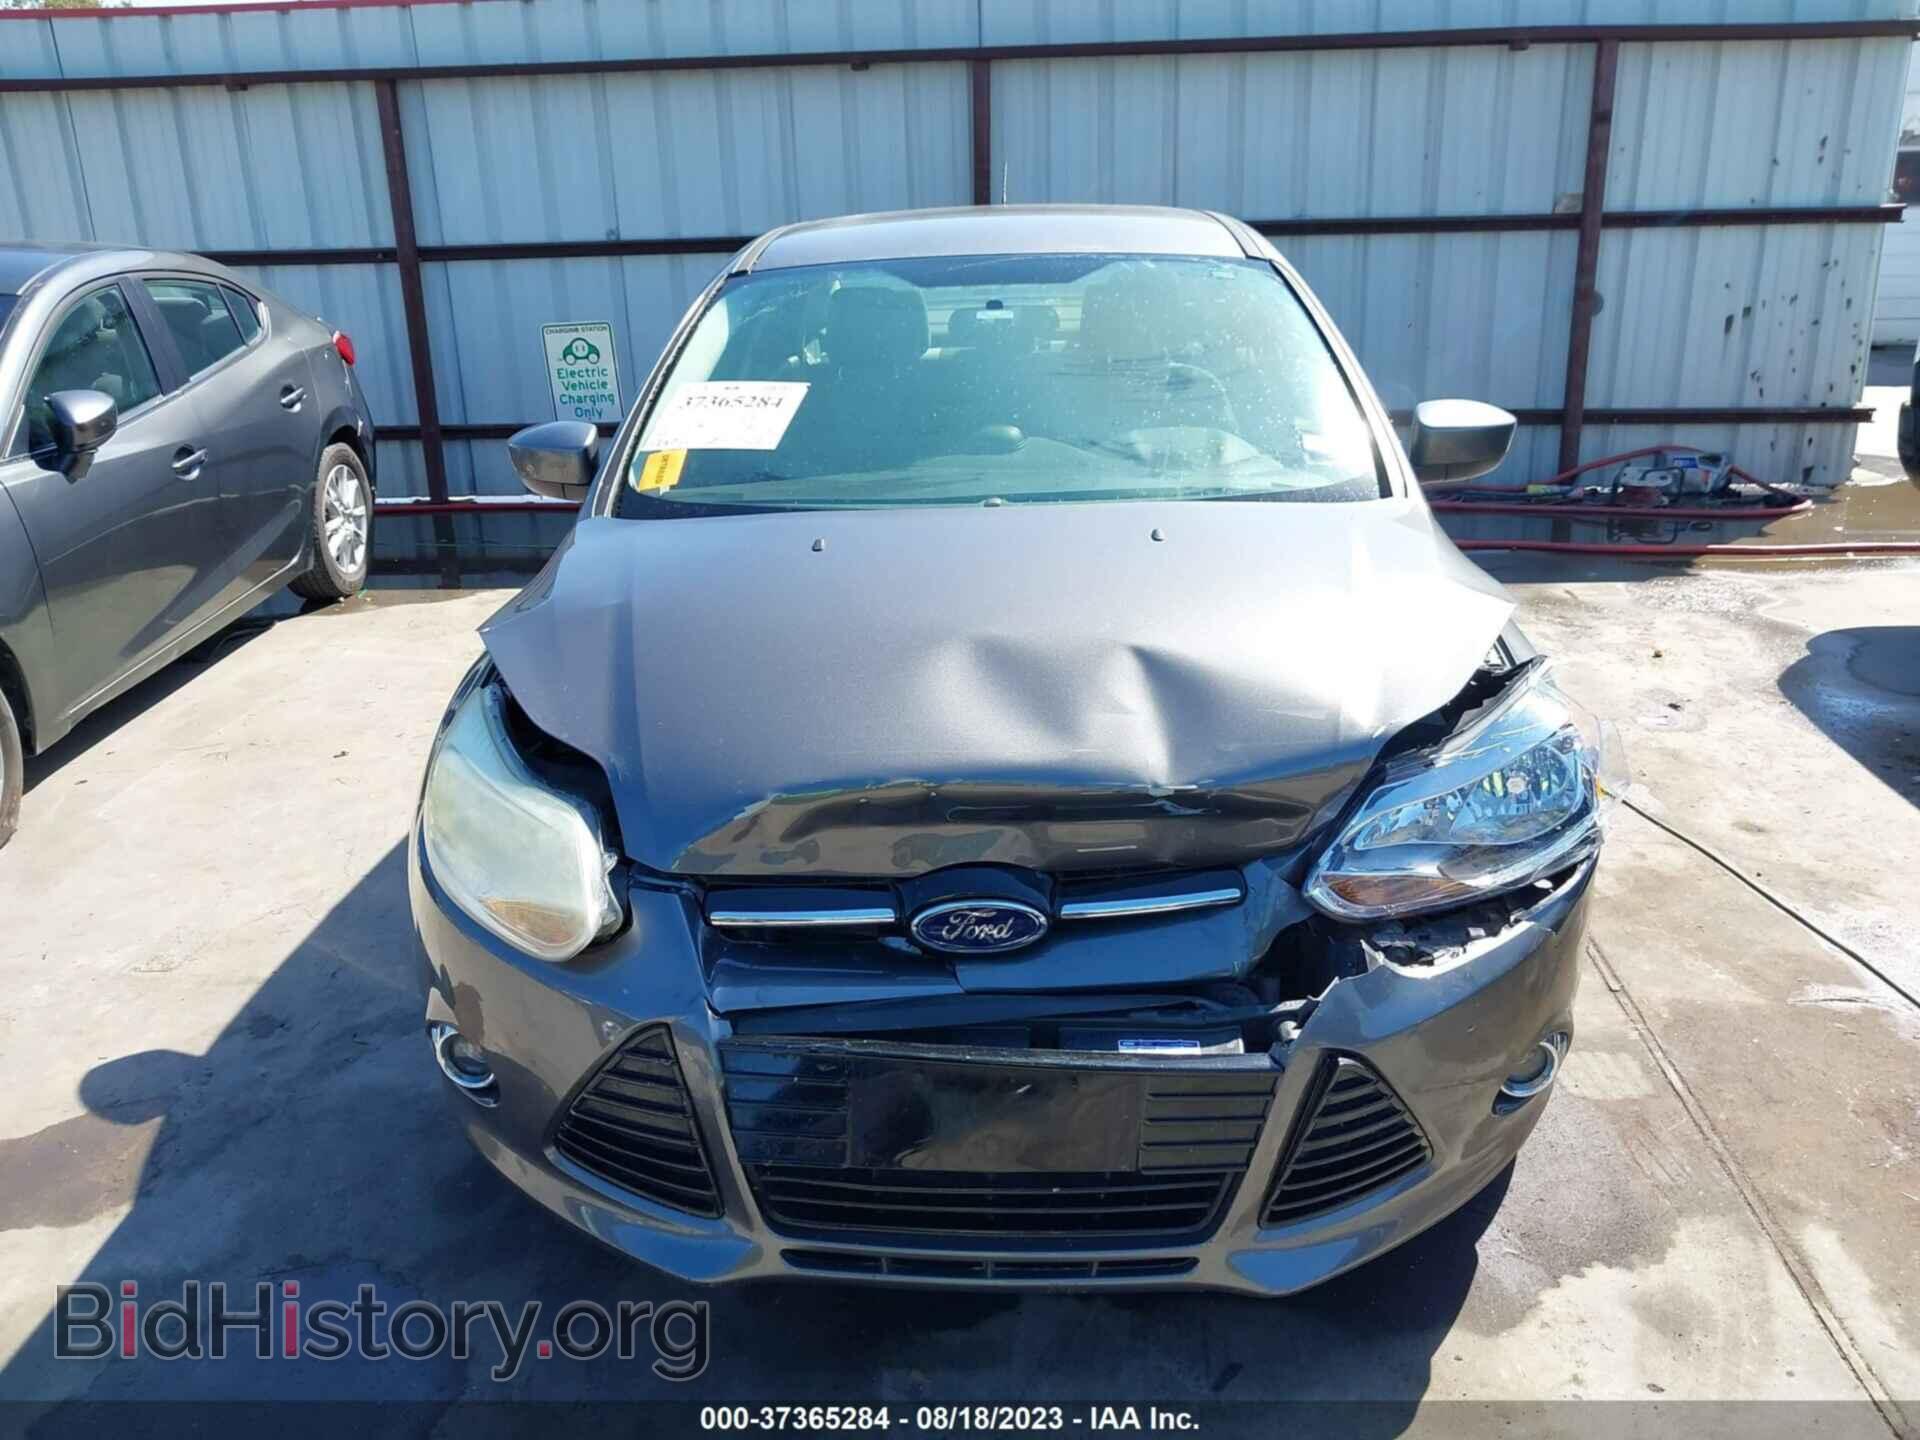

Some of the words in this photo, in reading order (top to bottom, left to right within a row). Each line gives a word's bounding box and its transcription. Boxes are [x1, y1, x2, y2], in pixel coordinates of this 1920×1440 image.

[580, 325, 608, 333] STATION
[556, 367, 609, 379] Electric
[561, 380, 609, 391] Vehicle
[560, 392, 615, 405] Charging
[574, 407, 603, 418] Only
[942, 910, 1015, 940] Ford
